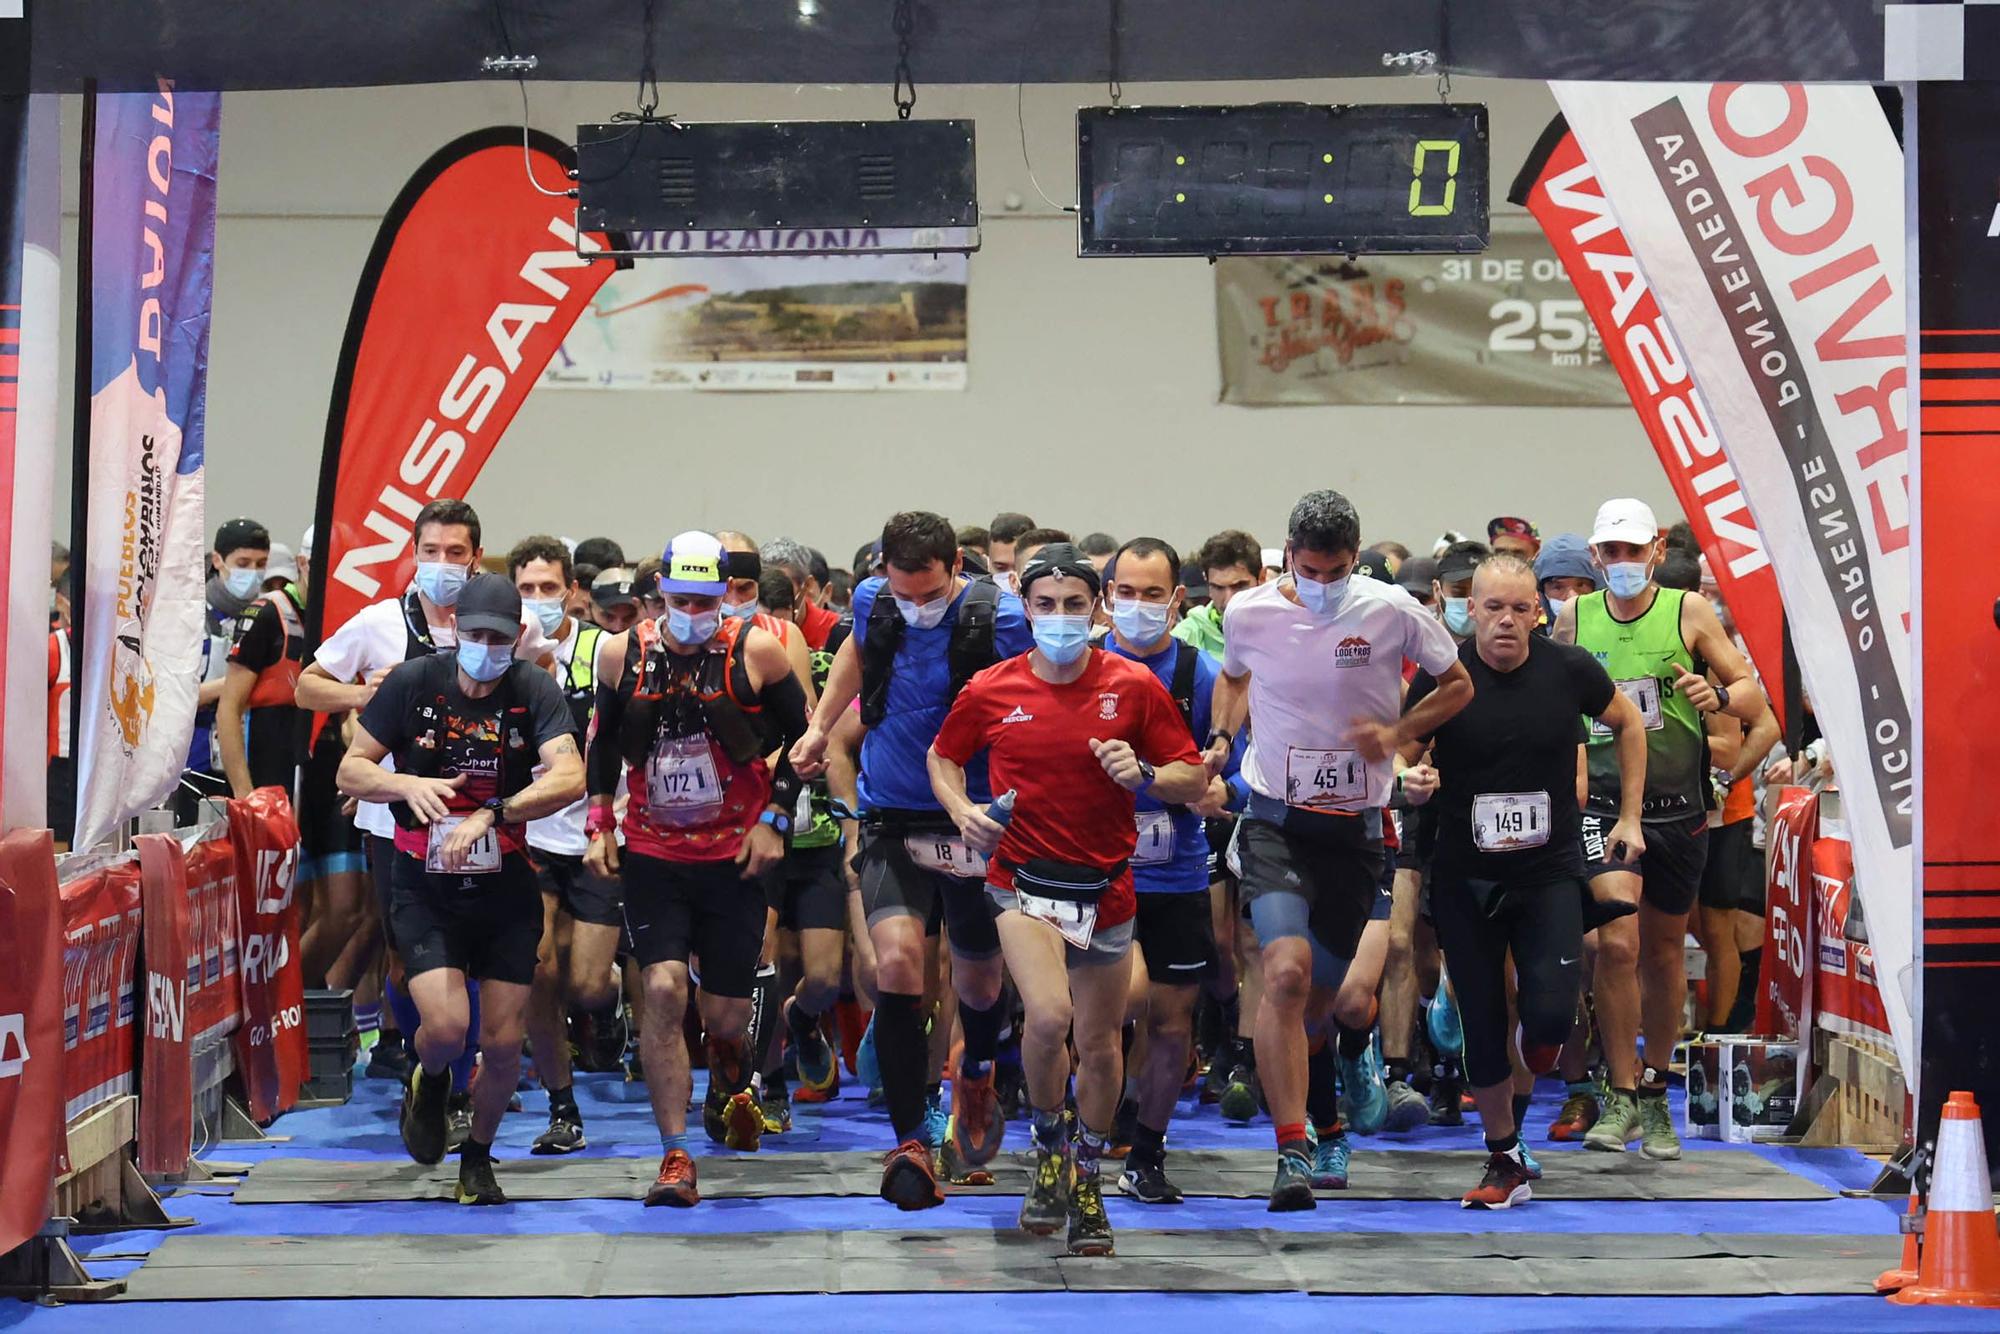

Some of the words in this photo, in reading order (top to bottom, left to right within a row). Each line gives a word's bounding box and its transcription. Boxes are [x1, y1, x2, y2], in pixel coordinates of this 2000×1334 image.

[1441, 258, 1472, 282] 31
[1481, 259, 1525, 282] DE
[1488, 299, 1588, 351] 25
[1552, 352, 1582, 366] km
[332, 216, 602, 599] NISSAN
[663, 773, 691, 793] 172
[1314, 768, 1338, 789] 45
[1495, 811, 1523, 833] 149
